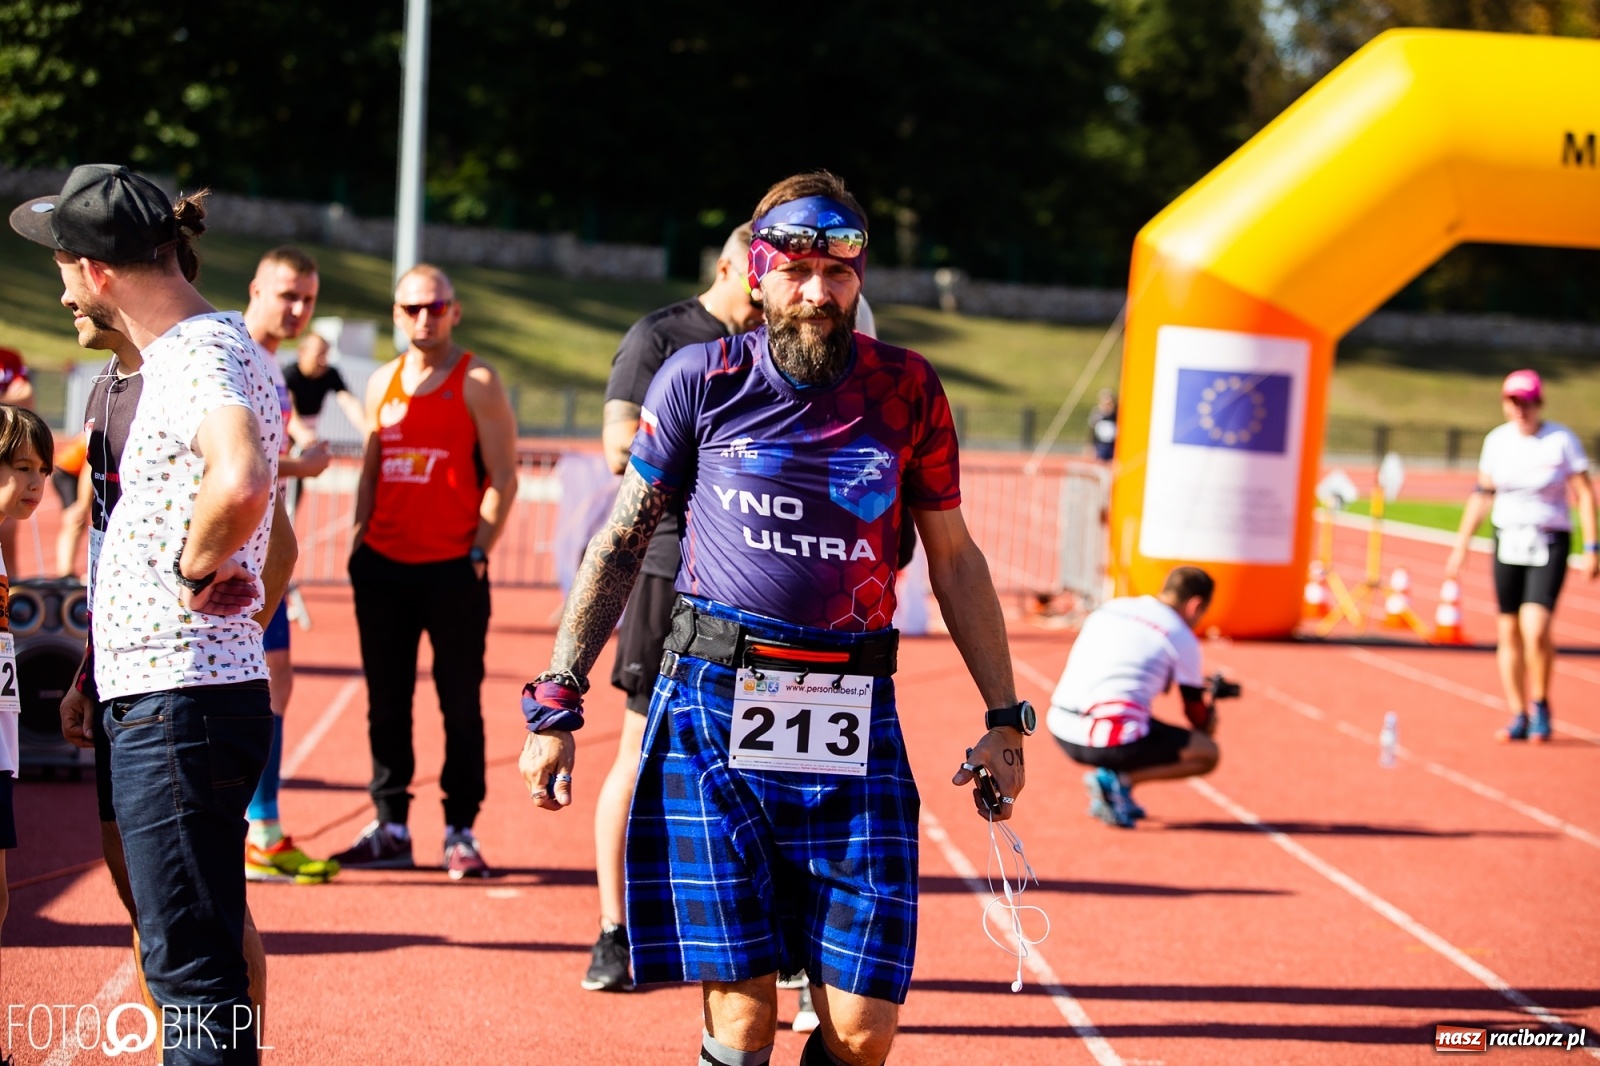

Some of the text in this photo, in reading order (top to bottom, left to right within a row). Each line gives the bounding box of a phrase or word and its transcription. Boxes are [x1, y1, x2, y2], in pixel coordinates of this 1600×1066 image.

[1562, 131, 1597, 169] M
[712, 484, 804, 521] YNO
[743, 525, 877, 562] ULTRA
[738, 706, 860, 757] 213
